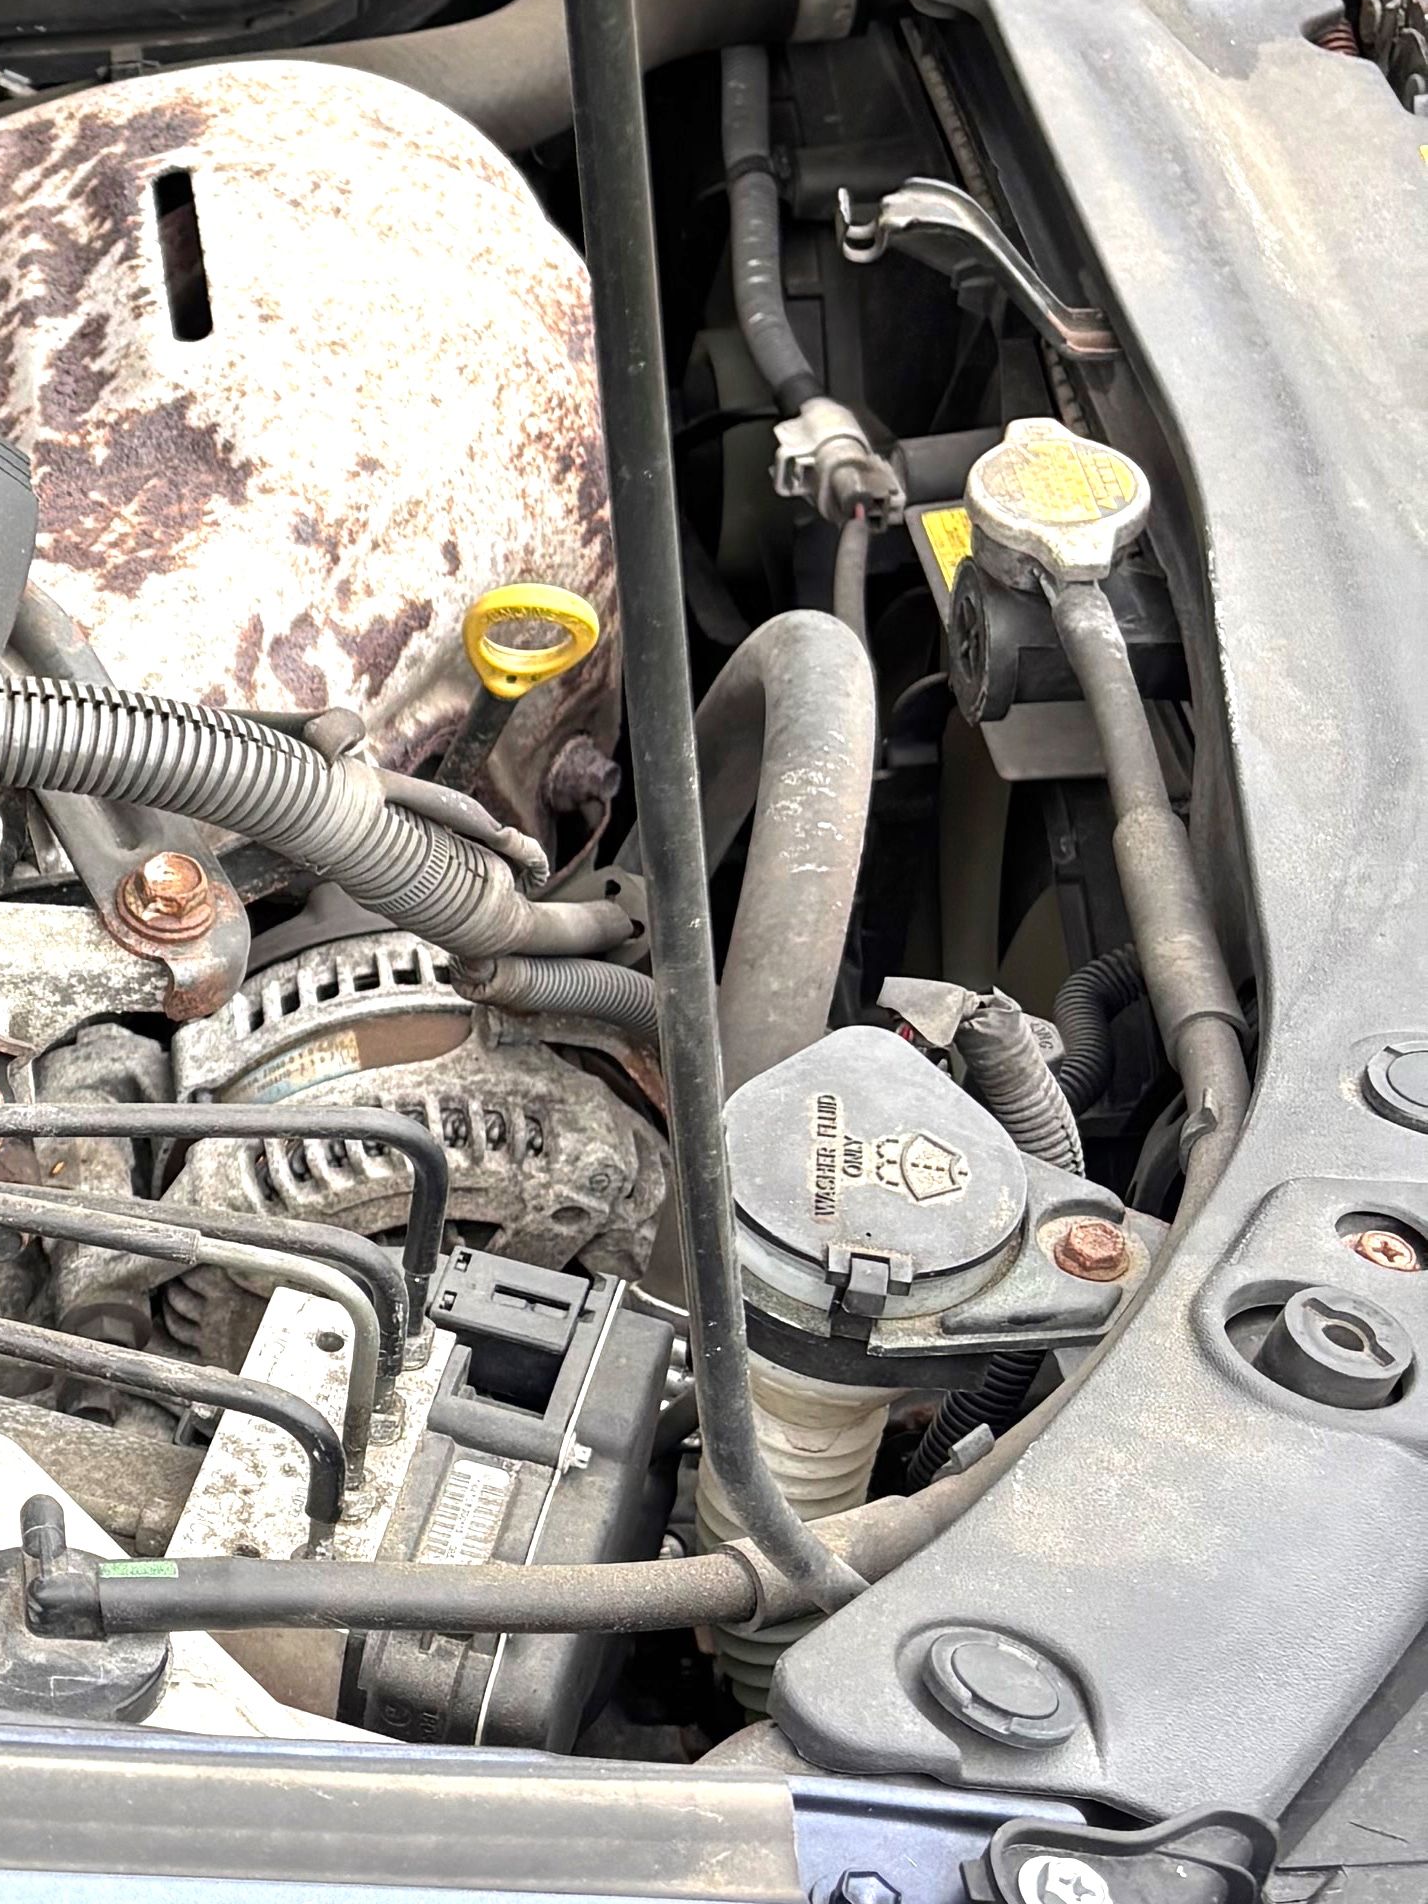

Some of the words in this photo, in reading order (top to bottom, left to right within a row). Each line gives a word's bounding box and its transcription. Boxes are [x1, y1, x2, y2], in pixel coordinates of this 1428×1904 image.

[817, 1094, 837, 1139] FLUID
[842, 1135, 863, 1178] ONLY
[814, 1147, 836, 1216] WASHER
